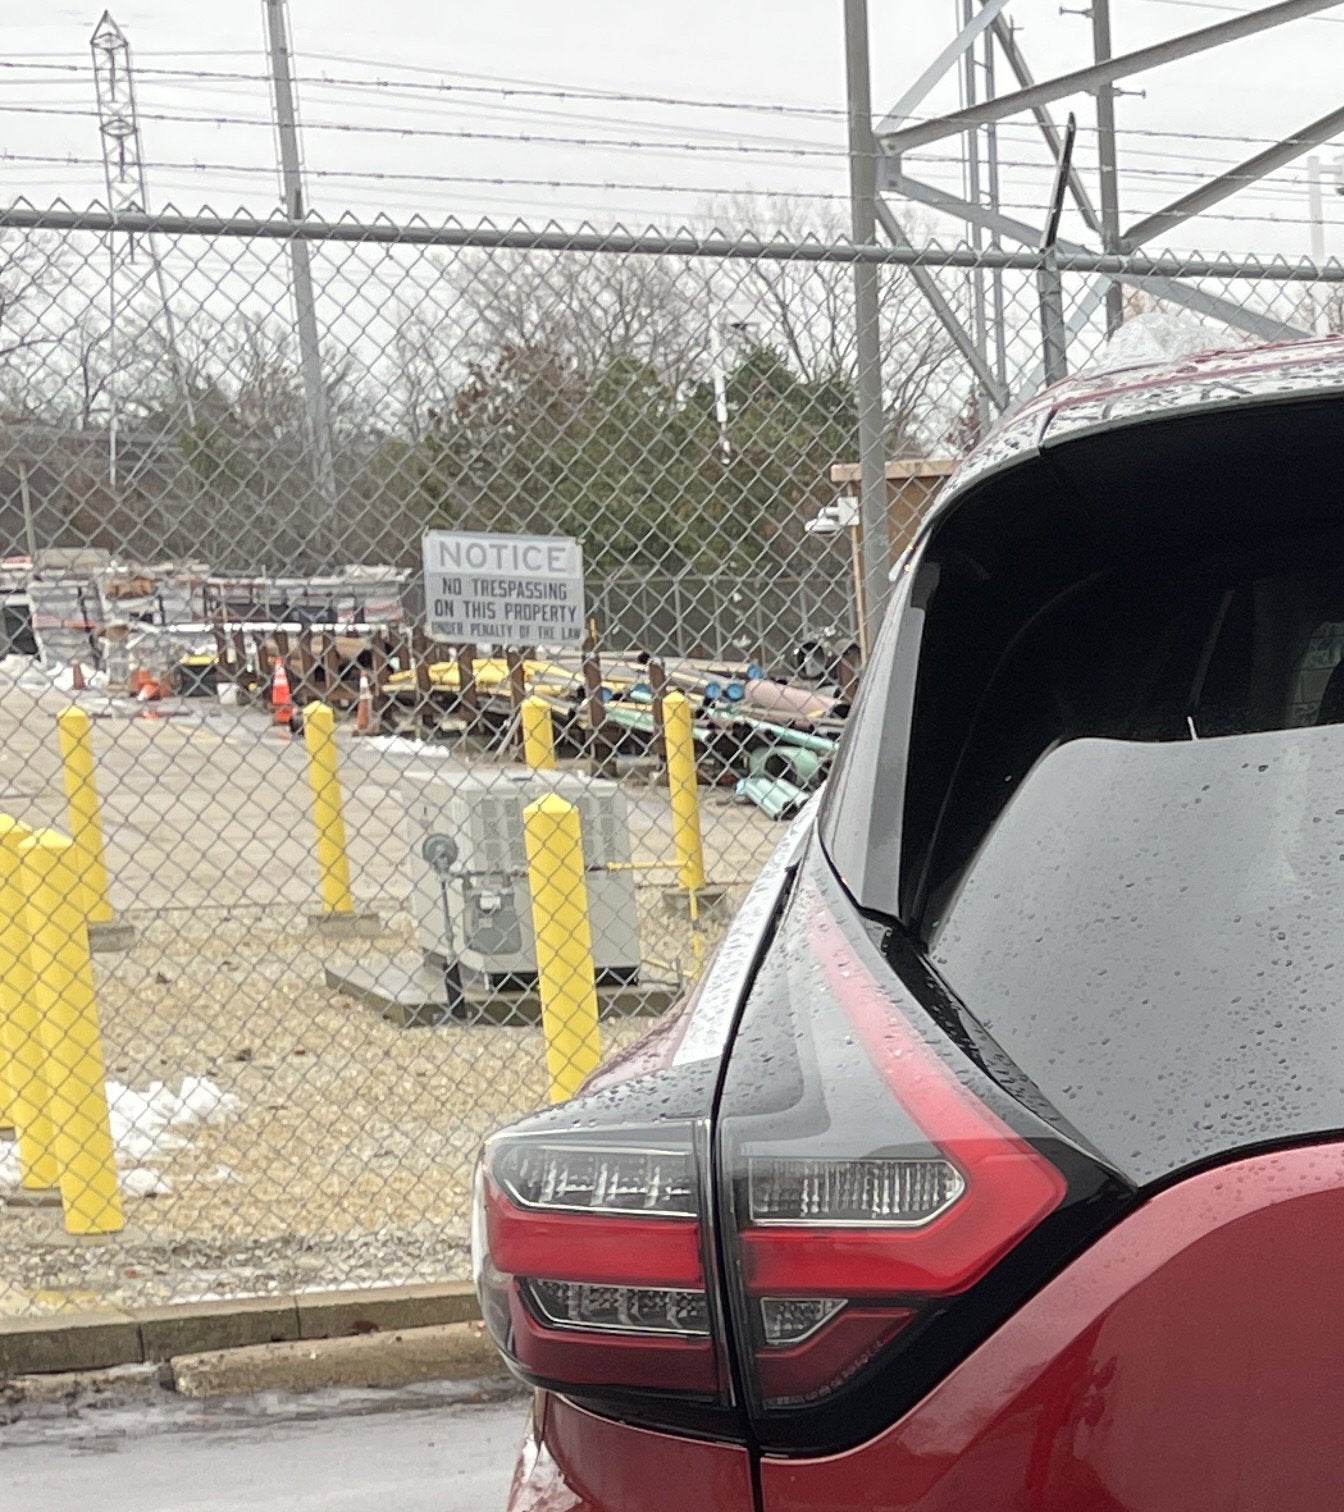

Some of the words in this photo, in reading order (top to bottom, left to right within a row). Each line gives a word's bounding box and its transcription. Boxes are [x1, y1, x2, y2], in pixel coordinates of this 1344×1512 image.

[439, 541, 566, 572] NOTICE
[442, 577, 462, 596] NO
[471, 578, 567, 600] TRESPASSING
[434, 599, 454, 617] ON
[463, 600, 496, 619] THIS
[504, 602, 576, 622] PROPERTY
[470, 623, 512, 639] PENALTY
[519, 625, 530, 639] OF
[538, 626, 554, 640] THE
[561, 627, 581, 640] LAW
